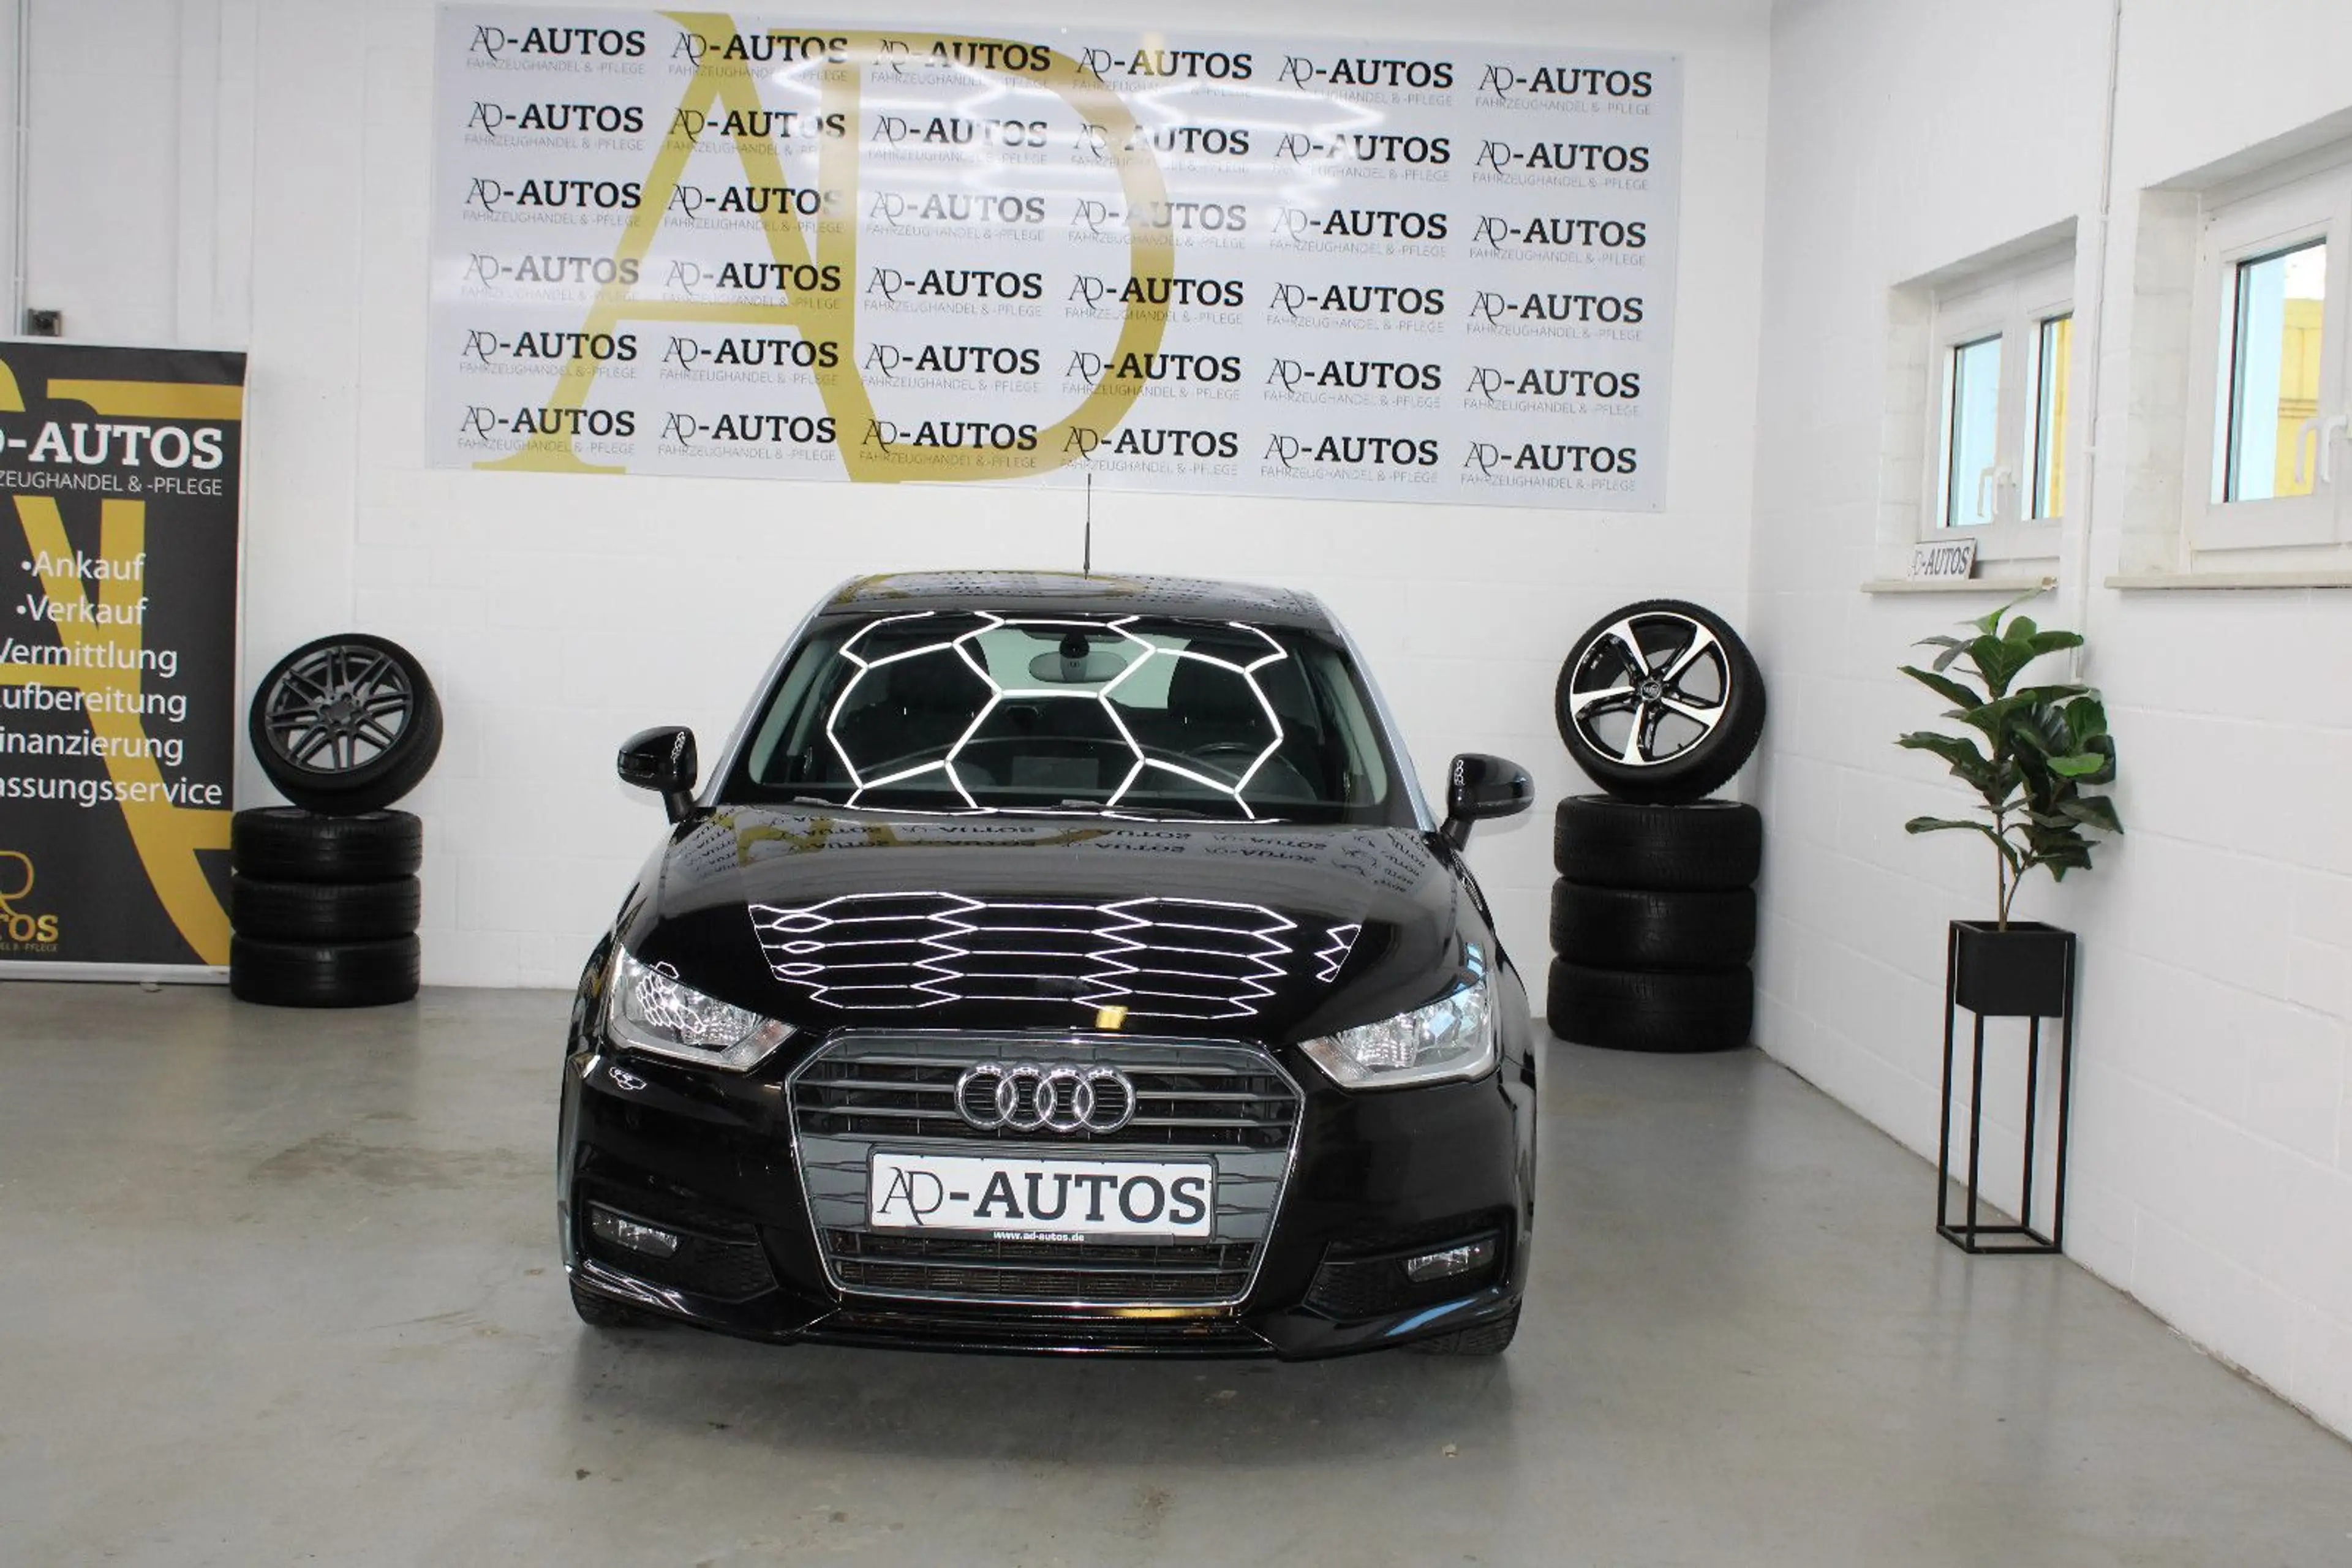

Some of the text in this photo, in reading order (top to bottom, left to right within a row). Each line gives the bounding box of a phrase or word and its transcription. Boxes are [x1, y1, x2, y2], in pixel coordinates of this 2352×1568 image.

[470, 25, 646, 59] AD-AUTOS
[672, 33, 848, 67] AD-AUTOS
[1077, 49, 1251, 83] AD-AUTOS
[1278, 56, 1452, 91] AD-AUTOS
[1479, 64, 1653, 99] AD-AUTOS
[468, 102, 643, 136] AD-AUTOS
[1476, 140, 1649, 174] AD-AUTOS
[466, 178, 641, 212] AD-AUTOS
[870, 192, 1045, 227] AD-AUTOS
[1273, 208, 1447, 242] AD-AUTOS
[1473, 215, 1646, 249] AD-AUTOS
[464, 254, 639, 288] AD-AUTOS
[666, 261, 841, 295] AD-AUTOS
[868, 268, 1042, 303] AD-AUTOS
[1069, 276, 1243, 310] AD-AUTOS
[1270, 283, 1444, 317] AD-AUTOS
[1470, 290, 1643, 325] AD-AUTOS
[462, 330, 637, 364] AD-AUTOS
[664, 337, 839, 371] AD-AUTOS
[865, 344, 1040, 379] AD-AUTOS
[1067, 352, 1241, 386] AD-AUTOS
[1267, 359, 1441, 393] AD-AUTOS
[1467, 366, 1640, 401] AD-AUTOS
[461, 405, 635, 440] AD-AUTOS
[662, 413, 836, 447] AD-AUTOS
[864, 420, 1038, 454] AD-AUTOS
[0, 421, 224, 470] -AUTOS
[1065, 427, 1238, 461] AD-AUTOS
[1264, 434, 1438, 469] AD-AUTOS
[1464, 442, 1637, 476] AD-AUTOS
[127, 475, 143, 493] &
[147, 477, 224, 496] -PFLEGE
[31, 549, 146, 581] Ankauf
[26, 593, 149, 626] Verkauf
[0, 680, 187, 723] ufbereitung
[876, 1166, 1207, 1226] AD-AUTOS
[993, 1231, 1084, 1243] www.ad-autos.de
